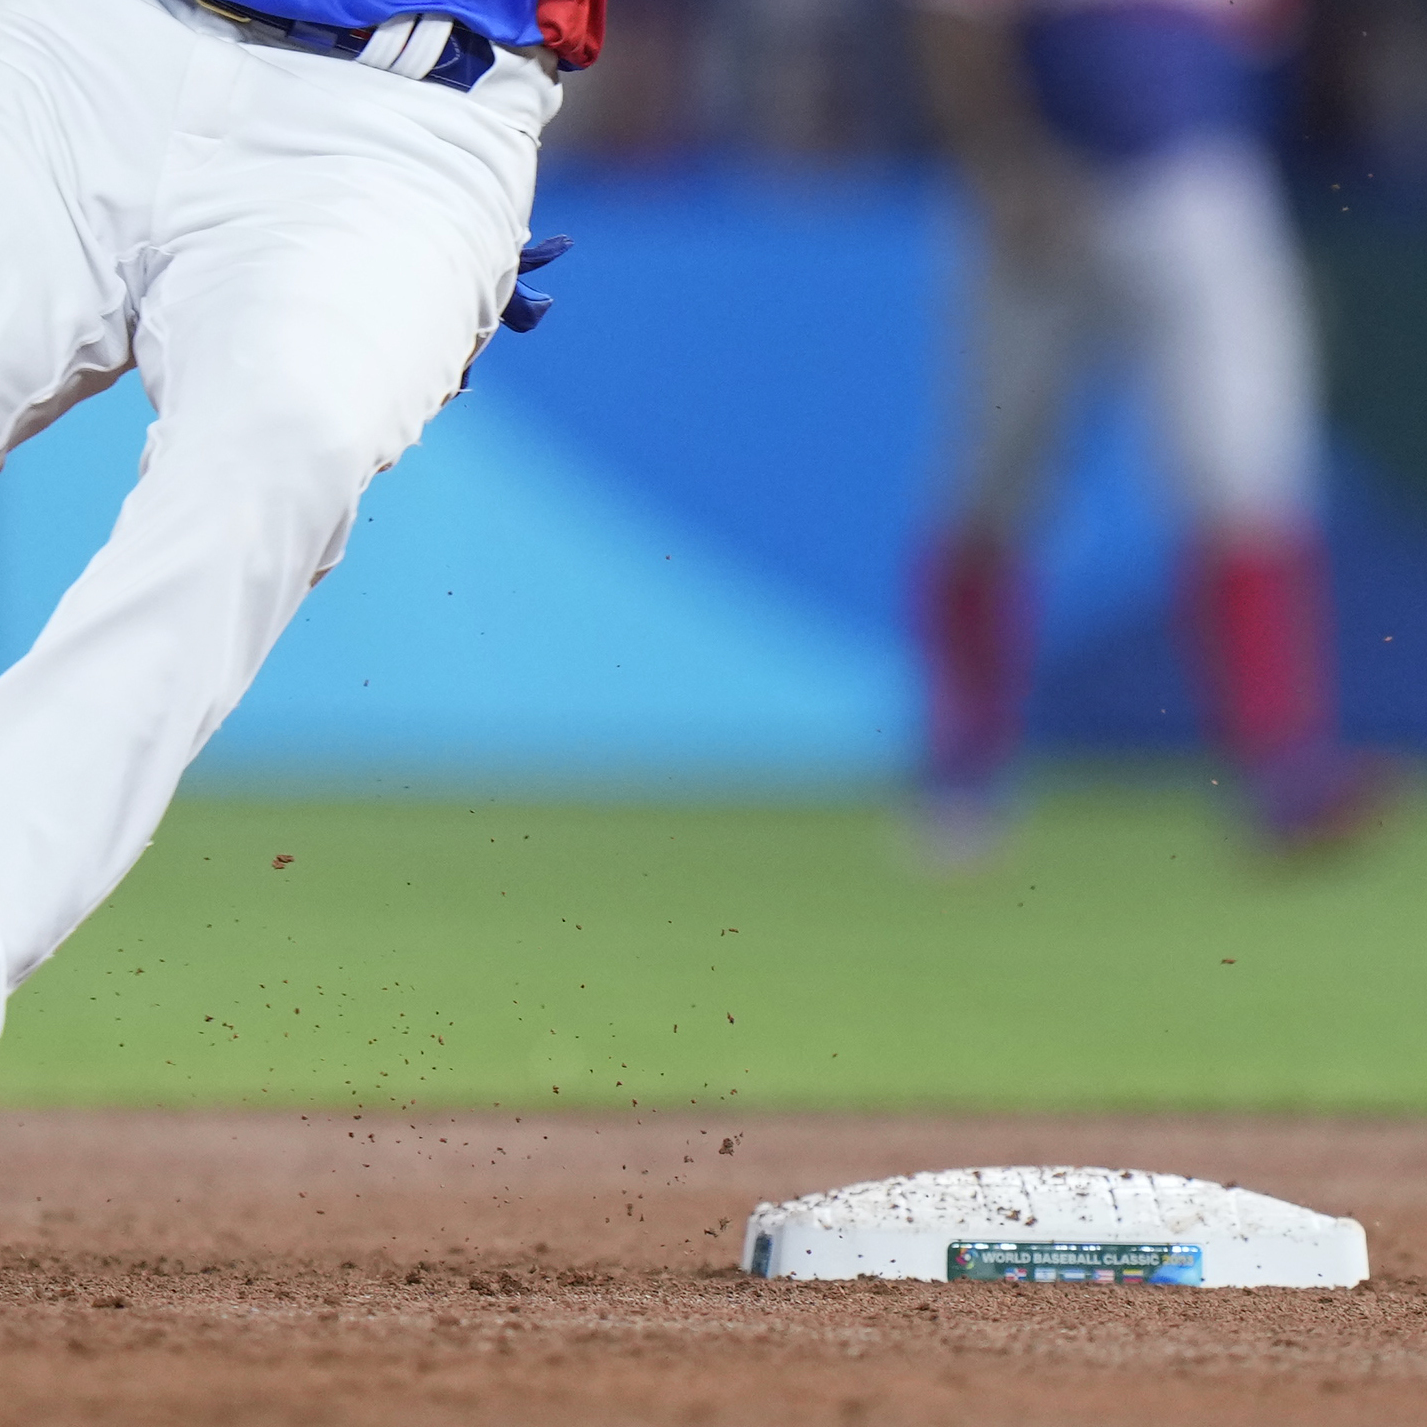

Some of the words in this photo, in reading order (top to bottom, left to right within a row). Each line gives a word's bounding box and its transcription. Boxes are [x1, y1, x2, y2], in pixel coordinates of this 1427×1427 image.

[982, 1251, 1031, 1264] WORLD
[1033, 1252, 1101, 1265] BASEBALL
[1103, 1253, 1160, 1266] CLASSIC
